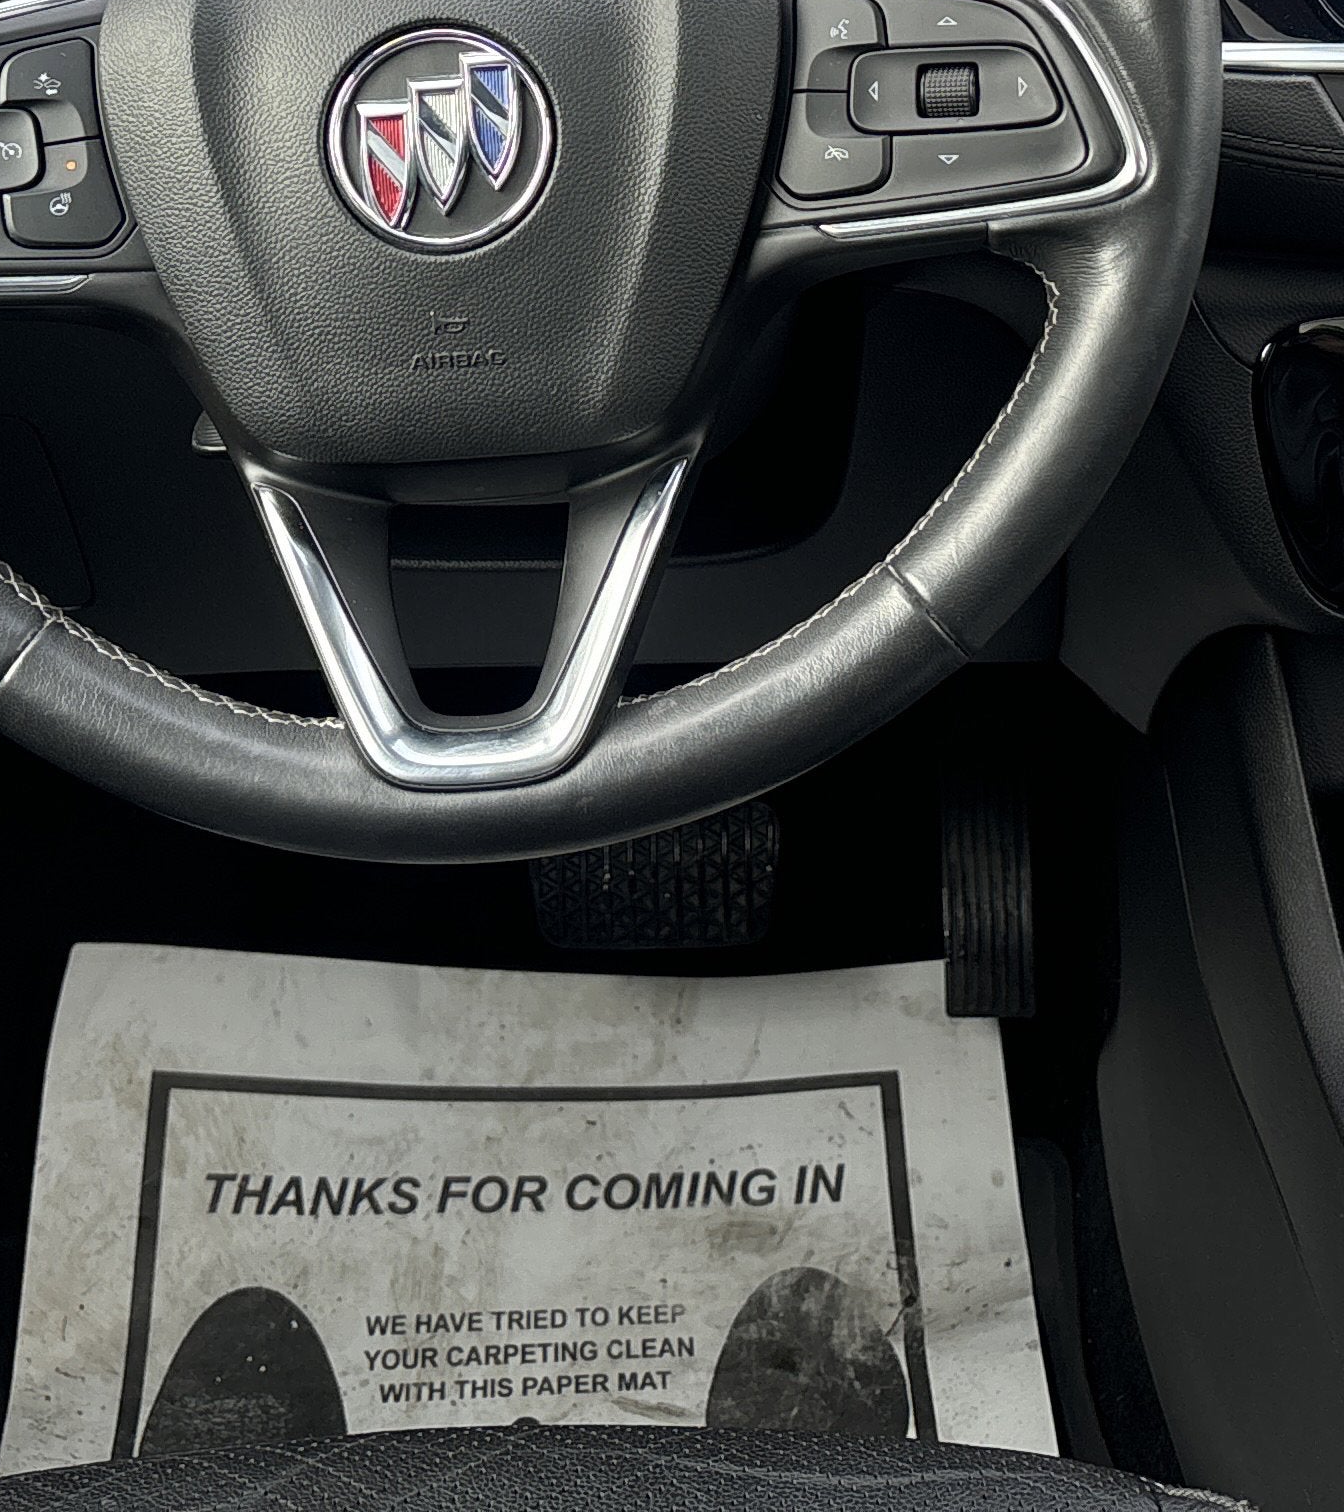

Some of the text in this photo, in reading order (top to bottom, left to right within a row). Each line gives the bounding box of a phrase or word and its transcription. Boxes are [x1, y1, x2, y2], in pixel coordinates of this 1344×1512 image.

[411, 349, 506, 372] AIRBAG
[203, 1163, 847, 1219] THANKS FOR COMING IN
[366, 1304, 686, 1336] WE HAVE TRIED TO KEEP
[364, 1336, 696, 1371] YOUR CARPETING CLEAN
[379, 1370, 672, 1404] WITH THIS PAPER MAT
